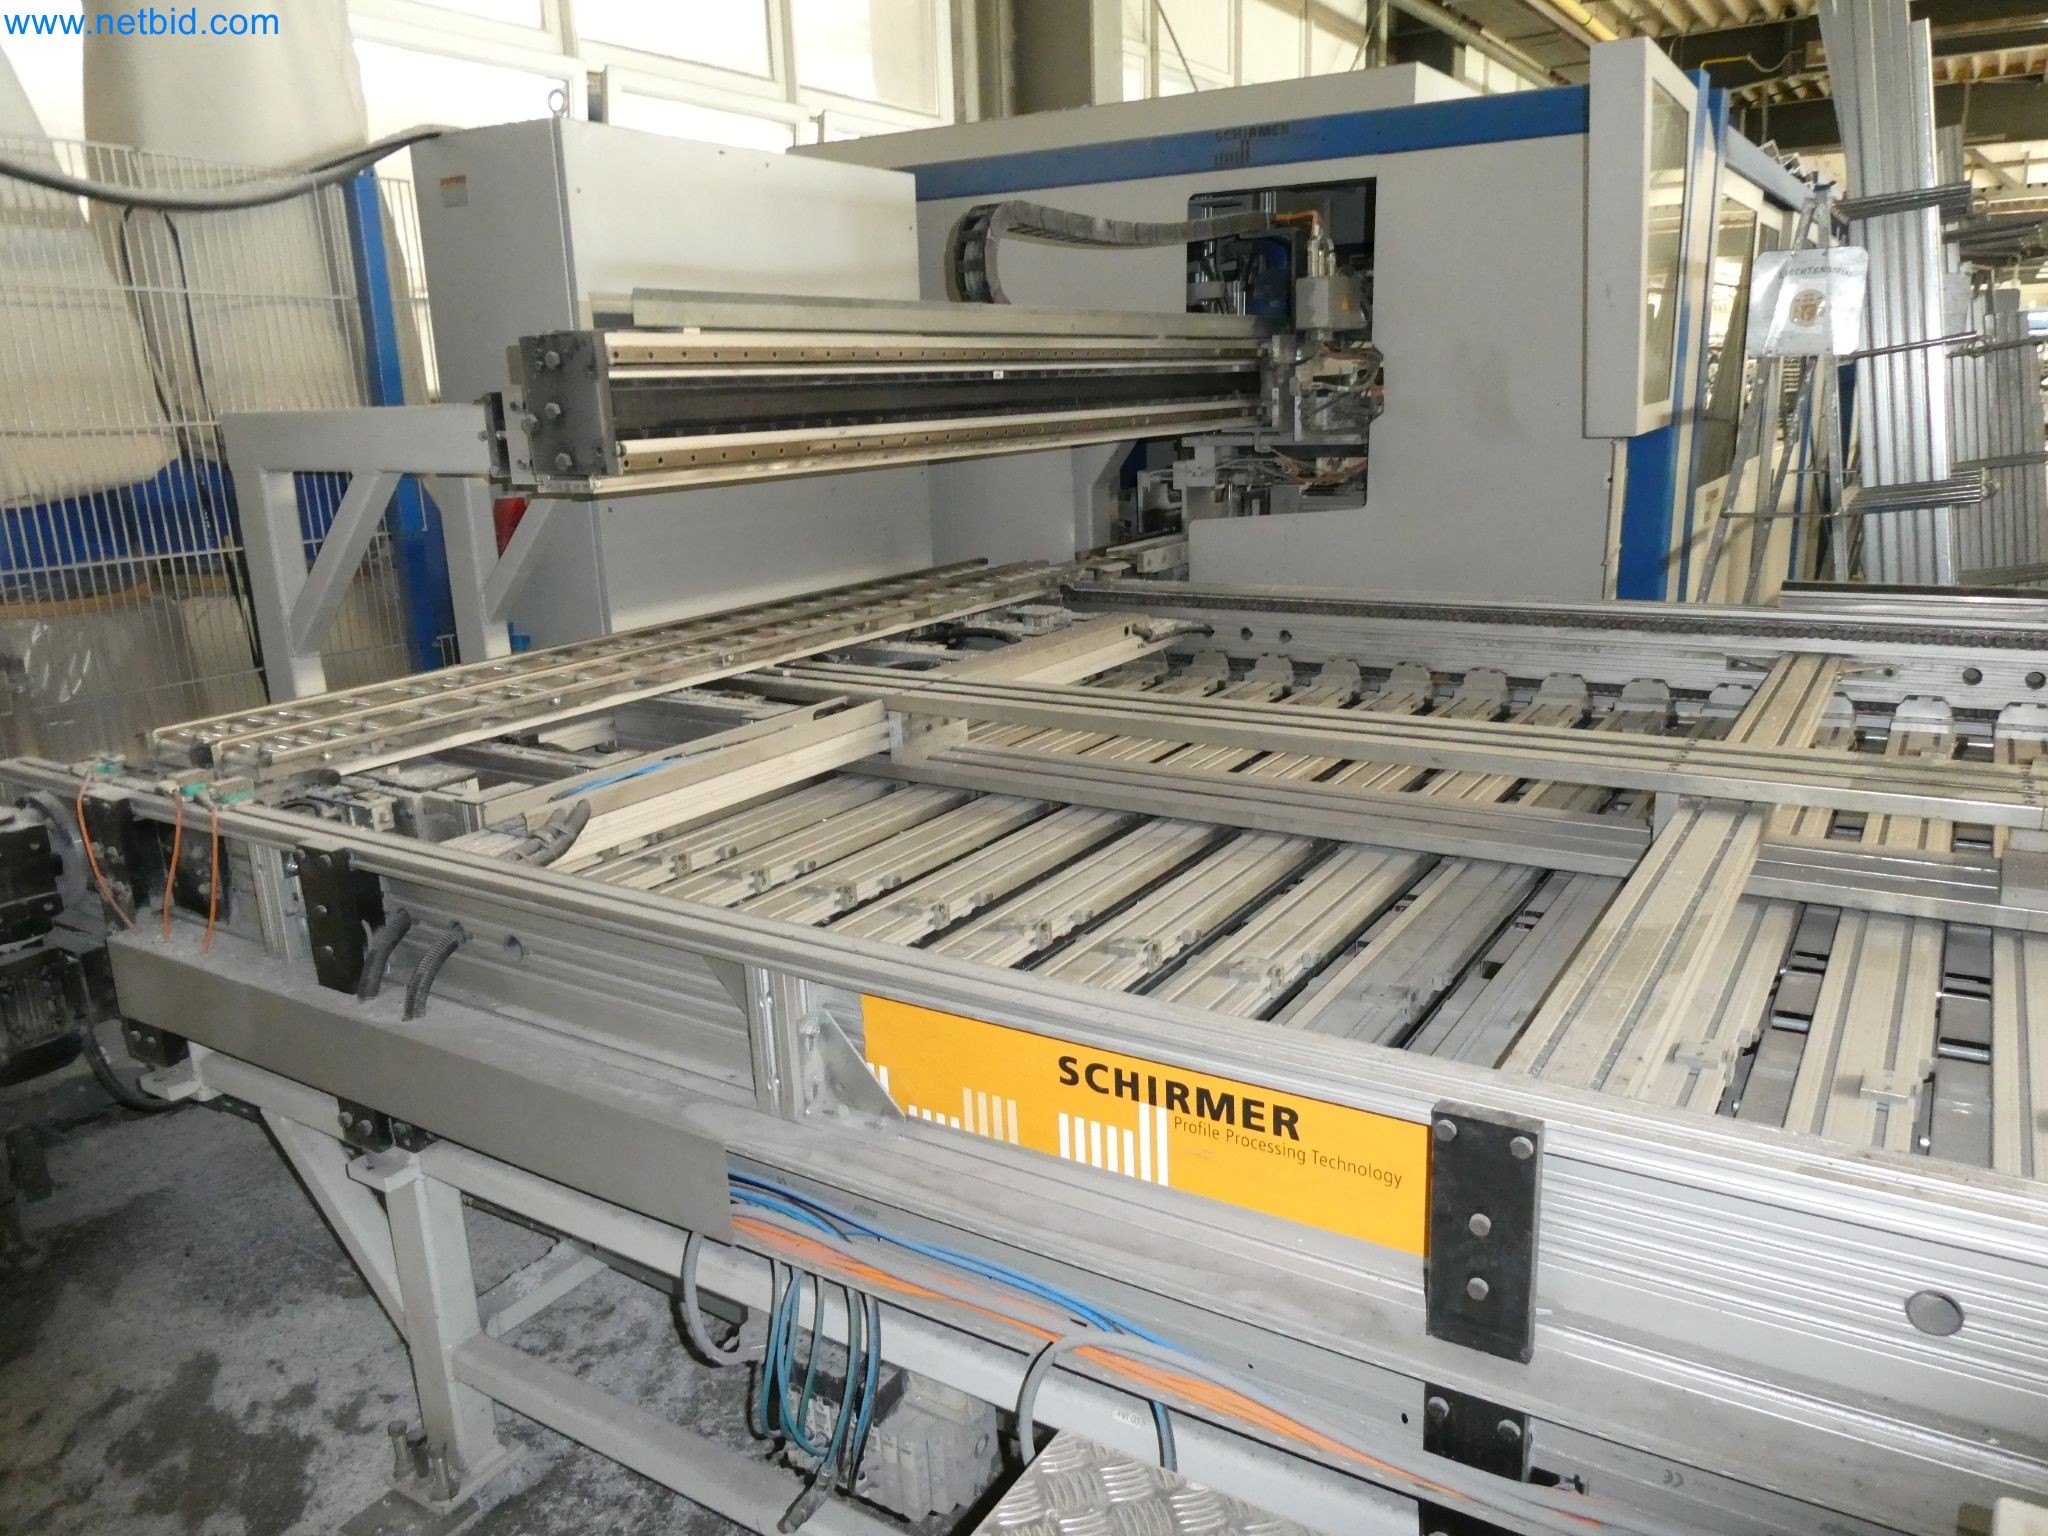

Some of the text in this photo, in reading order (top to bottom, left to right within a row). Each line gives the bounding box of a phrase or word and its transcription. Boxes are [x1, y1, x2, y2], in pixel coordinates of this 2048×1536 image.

[1058, 1055, 1300, 1141] SCHIRMER
[1174, 1116, 1402, 1188] Profile Processing Technology
